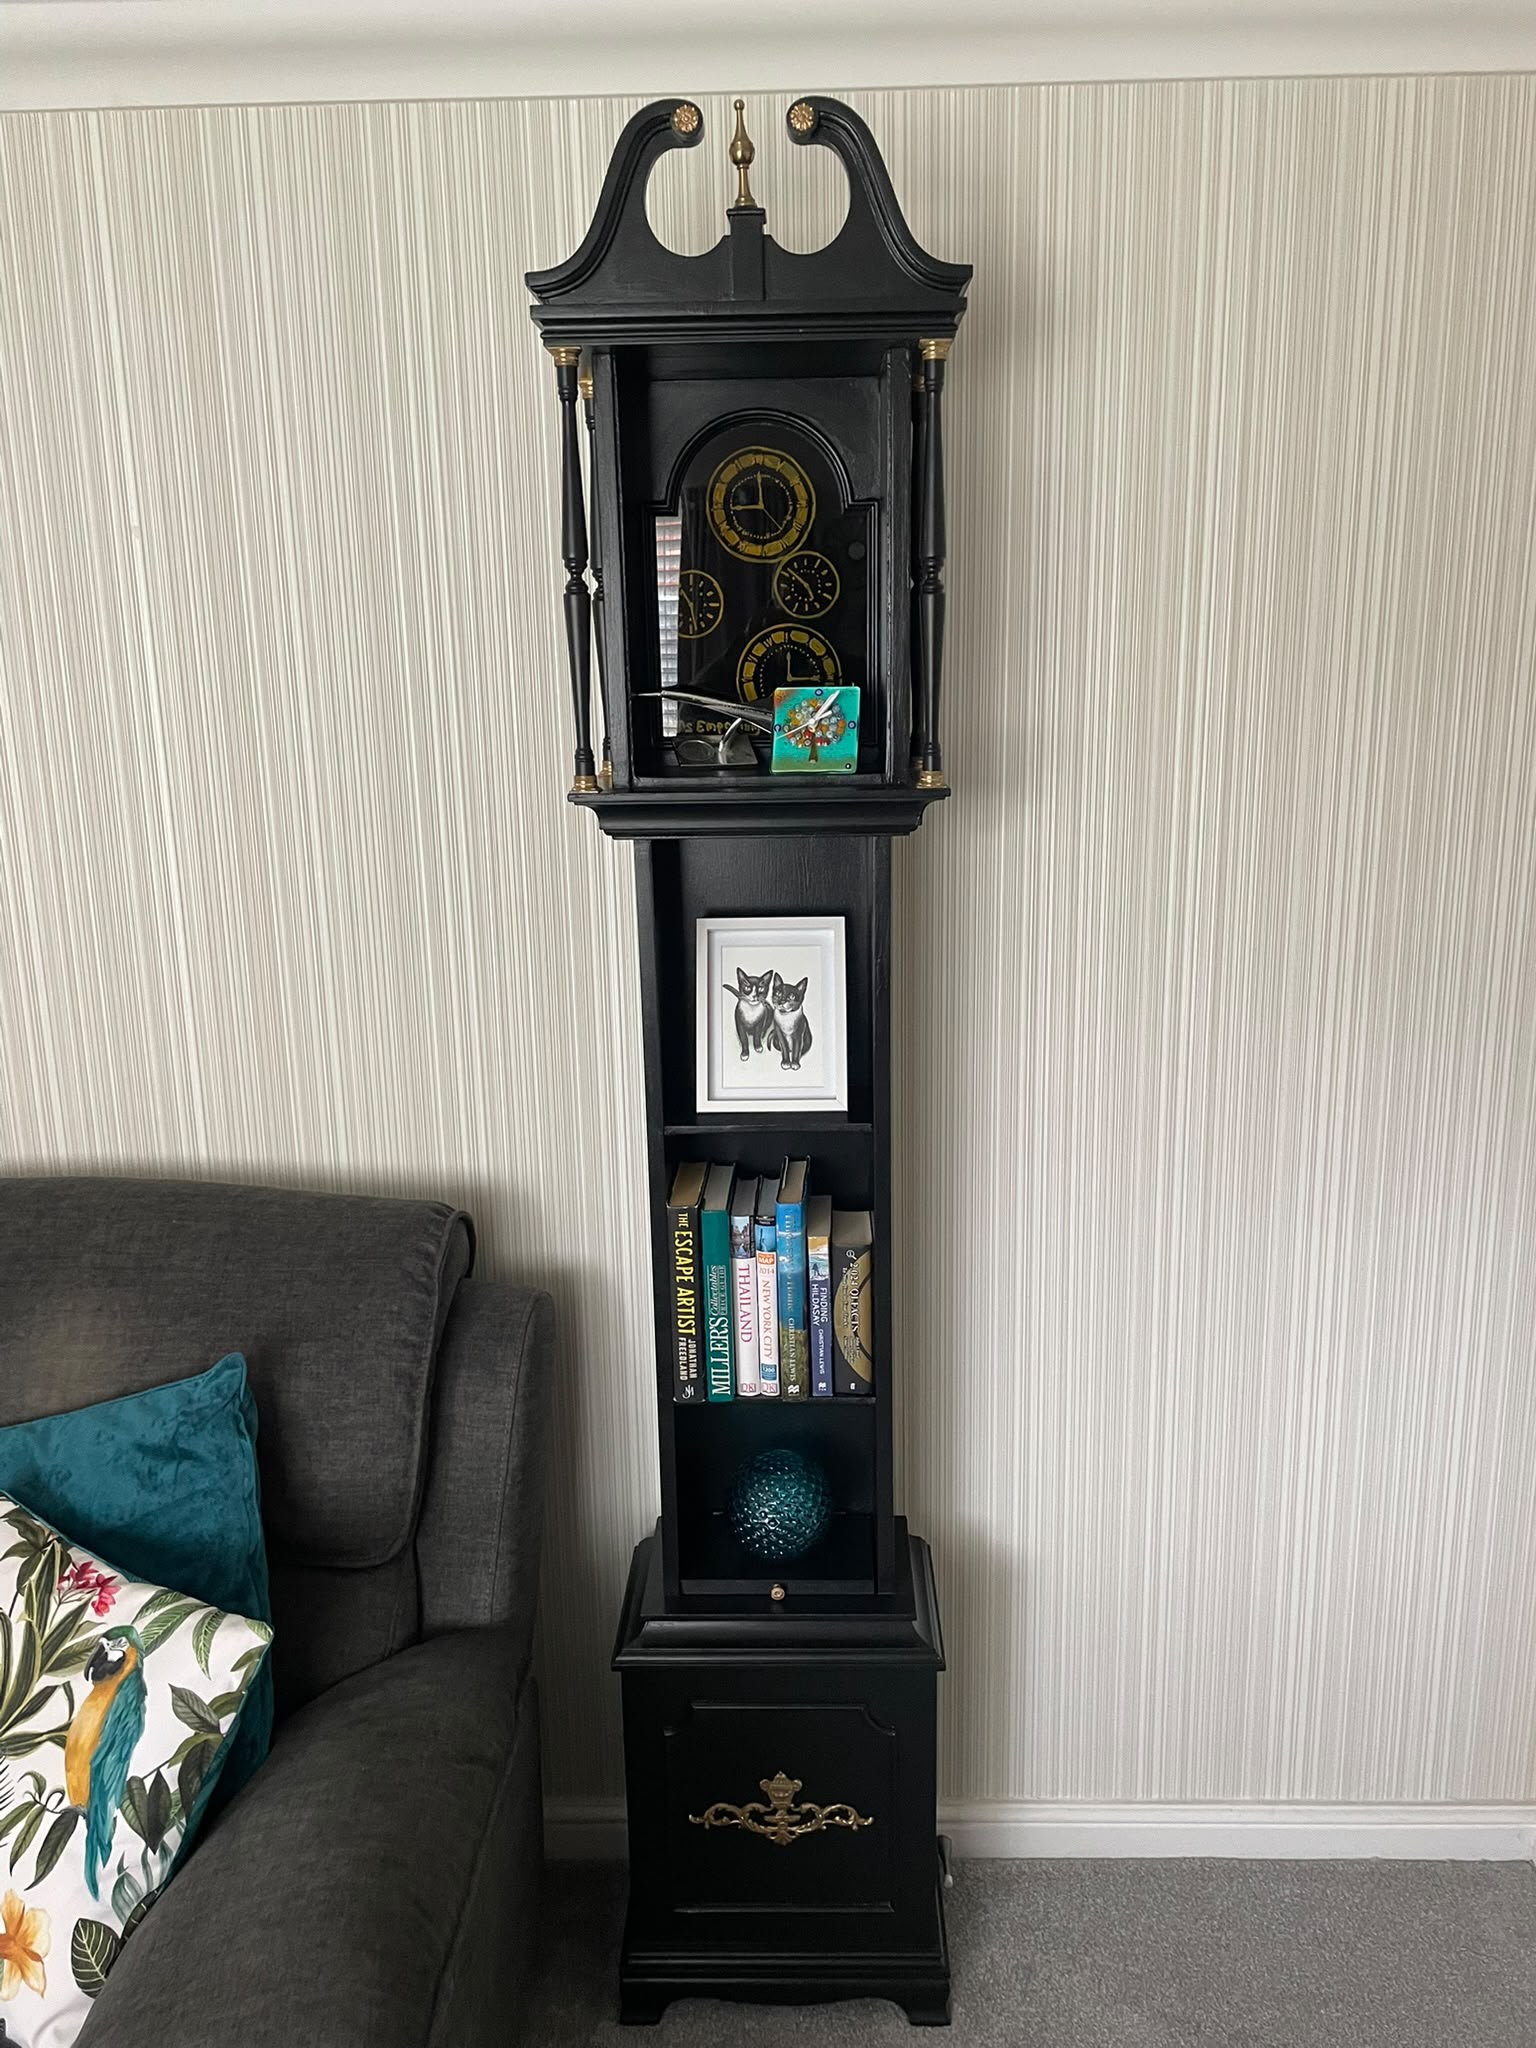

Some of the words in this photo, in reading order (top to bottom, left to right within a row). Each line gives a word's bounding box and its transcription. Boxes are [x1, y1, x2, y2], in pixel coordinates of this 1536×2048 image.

[677, 1212, 689, 1228] THE
[674, 1231, 694, 1283] ESCAPE
[758, 1256, 774, 1264] MAP
[676, 1287, 696, 1335] ARTIST
[709, 1265, 720, 1316] Collectables
[738, 1264, 753, 1343] THAILAND
[761, 1280, 771, 1304] NEW
[811, 1283, 820, 1326] HILDASAY
[820, 1287, 828, 1323] FINDING
[763, 1306, 772, 1333] YORK
[850, 1301, 859, 1332] FACTS
[678, 1337, 688, 1381] FREEDLAND
[687, 1338, 698, 1379] JONATHAN
[708, 1316, 731, 1396] MILLER'S
[765, 1336, 773, 1360] CITY
